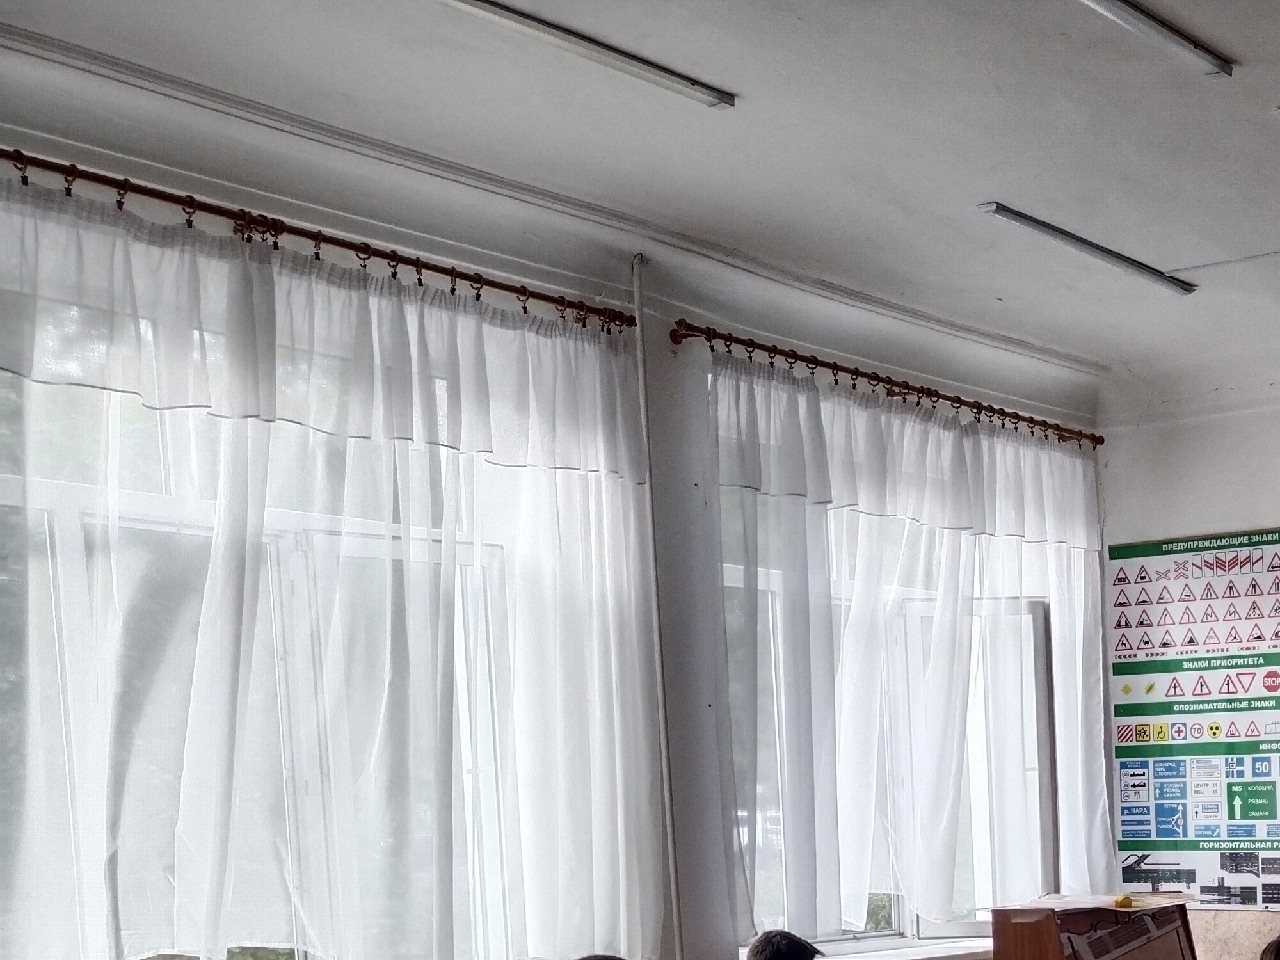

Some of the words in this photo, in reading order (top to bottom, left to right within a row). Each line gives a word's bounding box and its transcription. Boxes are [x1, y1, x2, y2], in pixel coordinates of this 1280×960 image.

[1162, 535, 1250, 551] ПРЕДУПРЕЖДАЮЩИЕ
[1250, 532, 1280, 542] ЗНАКИ
[1182, 660, 1209, 669] ЗНАКИ
[1210, 657, 1265, 668] ПРИОРИТЕТА
[1173, 700, 1249, 711] ОПОЗНАВАТЕЛЬНЫЕ
[1250, 699, 1276, 708] ЗНАКИ
[1255, 761, 1269, 773] 50
[1199, 841, 1272, 850] ГОРИЗОНТАЛЬНАЯ
